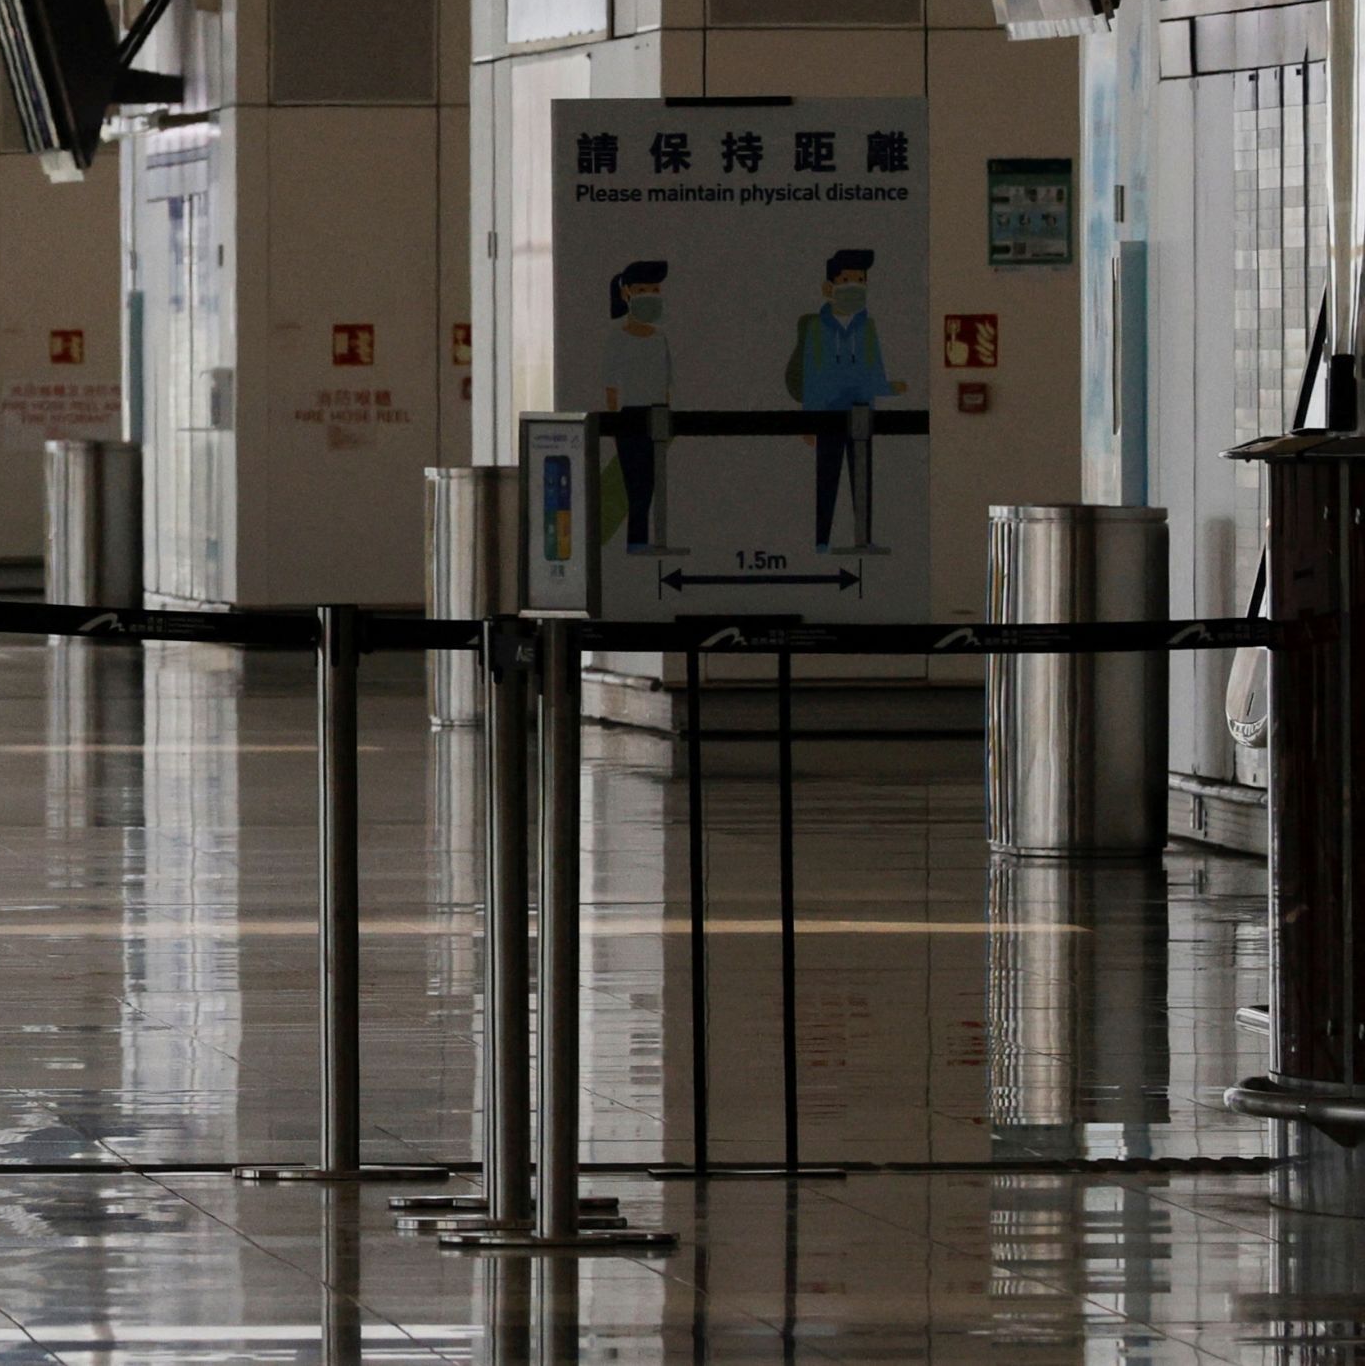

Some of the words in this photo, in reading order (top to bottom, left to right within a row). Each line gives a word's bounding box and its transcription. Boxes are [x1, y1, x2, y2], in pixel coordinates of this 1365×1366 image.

[576, 130, 910, 175] 請保持距離
[575, 184, 642, 203] Please
[647, 183, 735, 202] maintain
[739, 183, 821, 206] physical
[825, 183, 909, 202] distance
[735, 550, 788, 570] 1.5m
